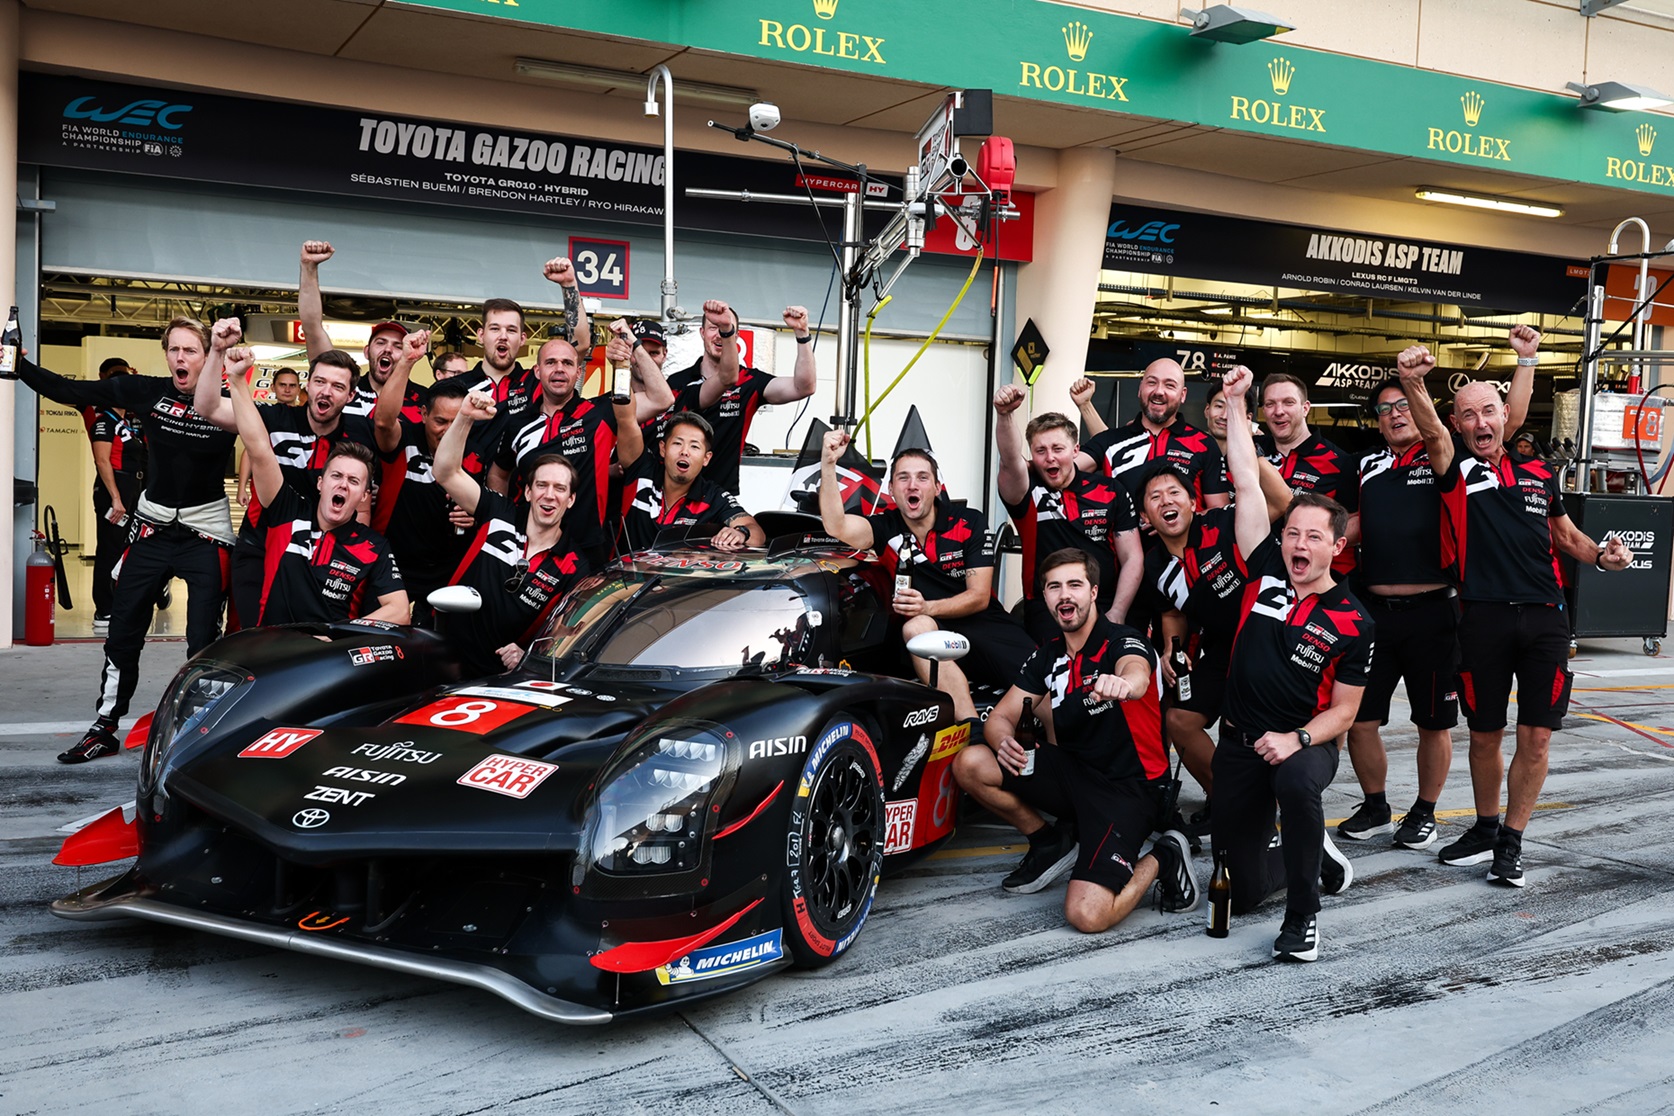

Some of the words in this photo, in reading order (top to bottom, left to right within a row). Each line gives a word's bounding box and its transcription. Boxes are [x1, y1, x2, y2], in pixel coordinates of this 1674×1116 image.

[758, 18, 886, 65] ROLEX
[1019, 61, 1129, 102] ROLEX
[62, 96, 194, 130] WEC
[1229, 95, 1326, 133] ROLEX
[62, 124, 79, 133] FIA
[82, 126, 120, 137] WORLD
[122, 131, 183, 144] ENDURANCE
[62, 132, 142, 147] CHAMPIONSHIP
[1427, 127, 1511, 161] ROLEX
[73, 142, 141, 154] PARTNERSHIP
[144, 143, 162, 154] FIA
[359, 117, 466, 163] TOYOTA
[471, 132, 567, 175] GAZOO
[569, 144, 665, 187] RACING
[1605, 156, 1674, 187] ROLEX
[444, 172, 496, 187] TOYOTA
[497, 178, 536, 191] GR010
[544, 184, 589, 196] HYBRID
[801, 178, 858, 191] HYPERCAR
[869, 185, 885, 194] HY
[350, 173, 419, 189] SÉBASTIEN
[422, 179, 460, 193] BUEMI
[468, 186, 526, 201] BRENDON
[529, 193, 581, 207] HARTLEY
[588, 200, 611, 211] RYO
[614, 203, 665, 216] HIRAKAW
[1106, 220, 1181, 243] WEC
[1105, 248, 1151, 257] CHAMPIONSHIP
[1117, 243, 1138, 251] WORLD
[1139, 245, 1175, 254] ENDURANCE
[1305, 234, 1384, 266] AKKODIS
[1384, 242, 1419, 270] ASP
[1421, 247, 1464, 275] TEAM
[575, 249, 624, 287] 34
[1281, 273, 1312, 282] ARNOLD
[1313, 276, 1336, 285] ROBIN
[1340, 279, 1370, 289] CONRAD
[1372, 282, 1404, 292] LAURSEN
[1408, 286, 1432, 295] KELVIN
[1432, 289, 1447, 297] VAN
[1448, 290, 1462, 298] DER
[1462, 292, 1482, 300] LINDE
[1351, 272, 1376, 280] LEXUS
[1377, 274, 1387, 282] RC
[1394, 276, 1418, 285] LMGT3
[1176, 349, 1206, 370] 78
[1333, 377, 1353, 388] ASP
[156, 402, 184, 418] GR
[1629, 409, 1658, 437] 78
[562, 436, 586, 447] FUJITSU
[562, 447, 580, 456] Mobil
[1291, 480, 1315, 490] DENSO
[1522, 487, 1546, 495] DENSO
[1524, 493, 1547, 506] FUJITSU
[1526, 505, 1542, 515] Mobil
[1084, 518, 1108, 526] DENSO
[328, 568, 356, 582] DENSO
[1206, 561, 1228, 581] DENSO
[1212, 570, 1235, 591] FUJITSU
[322, 588, 341, 600] Mobil
[325, 578, 352, 592] FUJITSU
[525, 586, 548, 602] FUJITSU
[531, 578, 554, 592] DENSO
[1218, 584, 1234, 599] Mobil
[519, 594, 537, 608] Mobil
[944, 640, 961, 650] Mobil
[1302, 632, 1331, 652] DENSO
[352, 652, 374, 664] GR
[394, 645, 405, 660] 8
[1290, 654, 1312, 669] Mobil
[1296, 643, 1325, 664] FUJITSU
[429, 700, 498, 727] 8
[903, 705, 940, 728] RAYS
[1088, 703, 1109, 716] Mobil
[247, 732, 311, 753] HY
[749, 735, 807, 760] AISIN
[811, 723, 849, 771] MICHELIN
[938, 728, 967, 753] DHL
[351, 741, 443, 765] FUJITSU
[321, 766, 407, 787] AISIN
[485, 756, 550, 779] HYPER
[467, 766, 537, 794] CAR
[303, 785, 376, 807] ZENT
[792, 810, 802, 824] FL
[885, 804, 914, 822] YPER
[884, 823, 911, 850] AR
[796, 902, 806, 914] H
[695, 939, 775, 971] MICHELIN
